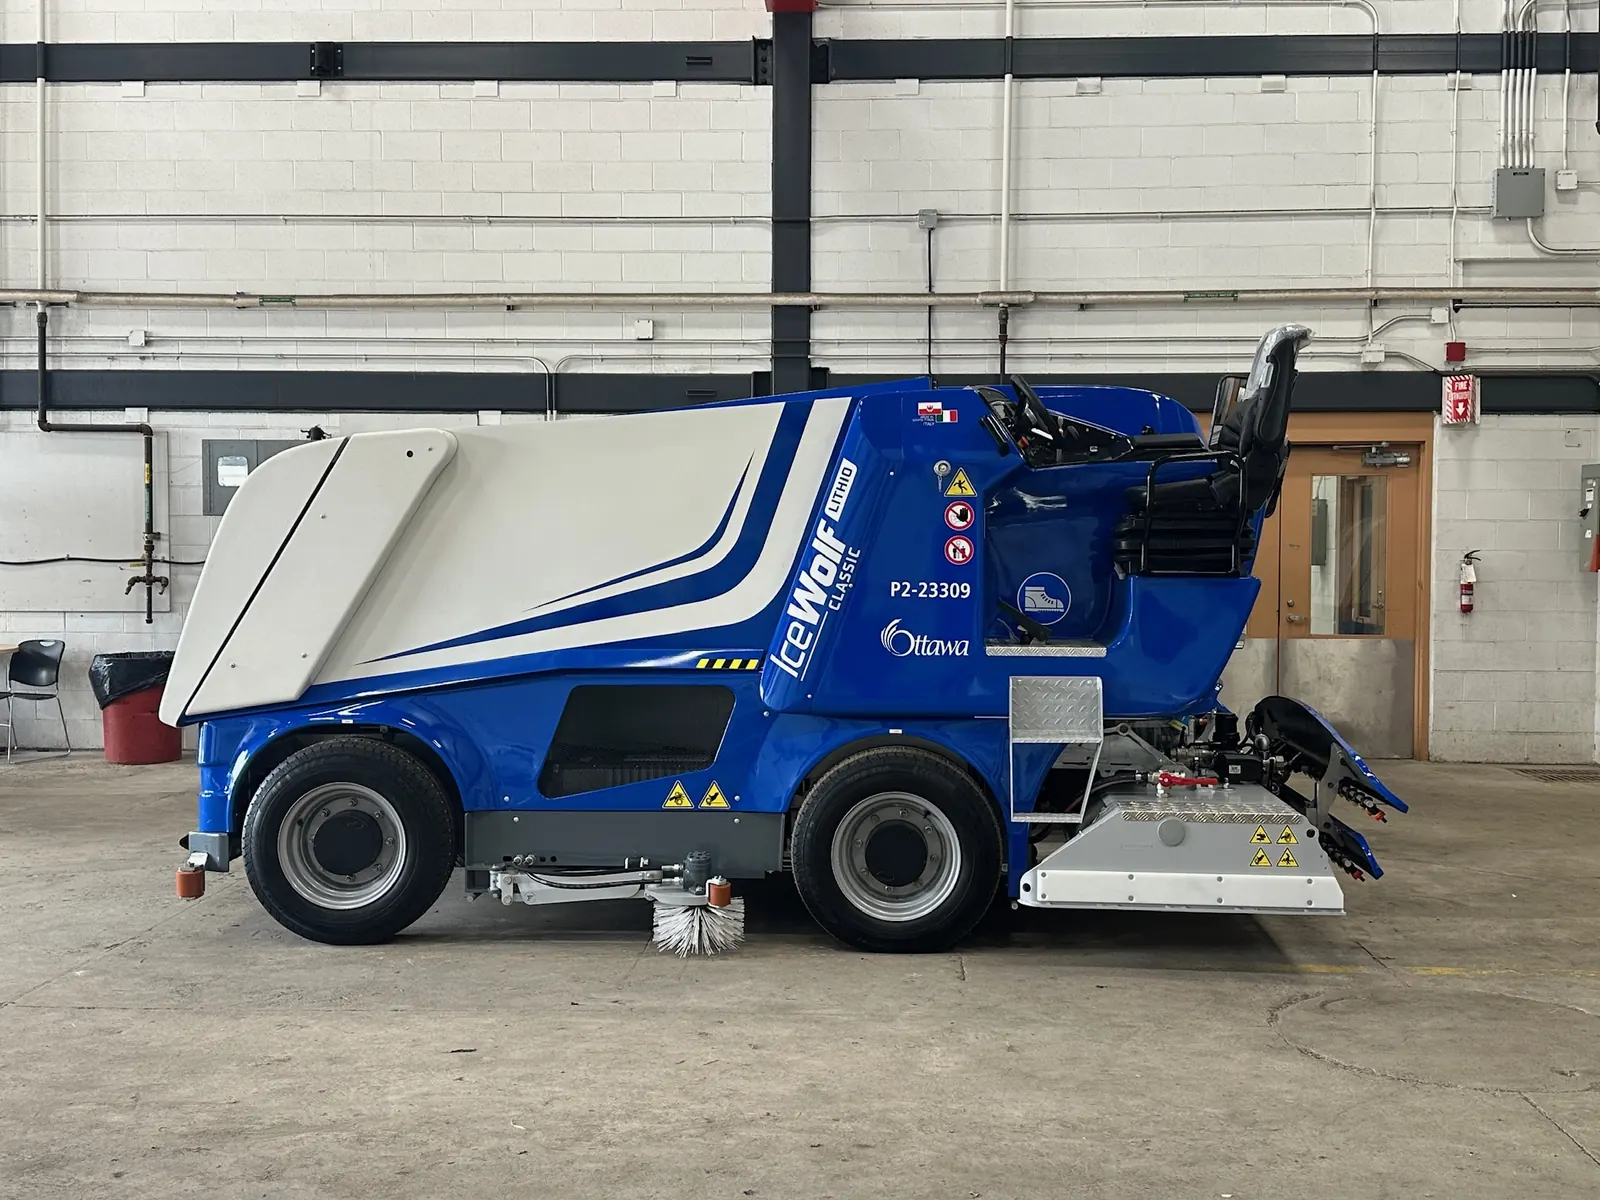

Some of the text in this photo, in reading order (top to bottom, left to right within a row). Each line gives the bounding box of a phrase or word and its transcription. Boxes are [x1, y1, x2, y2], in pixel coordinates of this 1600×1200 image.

[829, 467, 853, 513] LITHIO
[828, 547, 861, 611] CLASSIC
[890, 582, 971, 598] P2-23309
[882, 621, 969, 657] Ottawa
